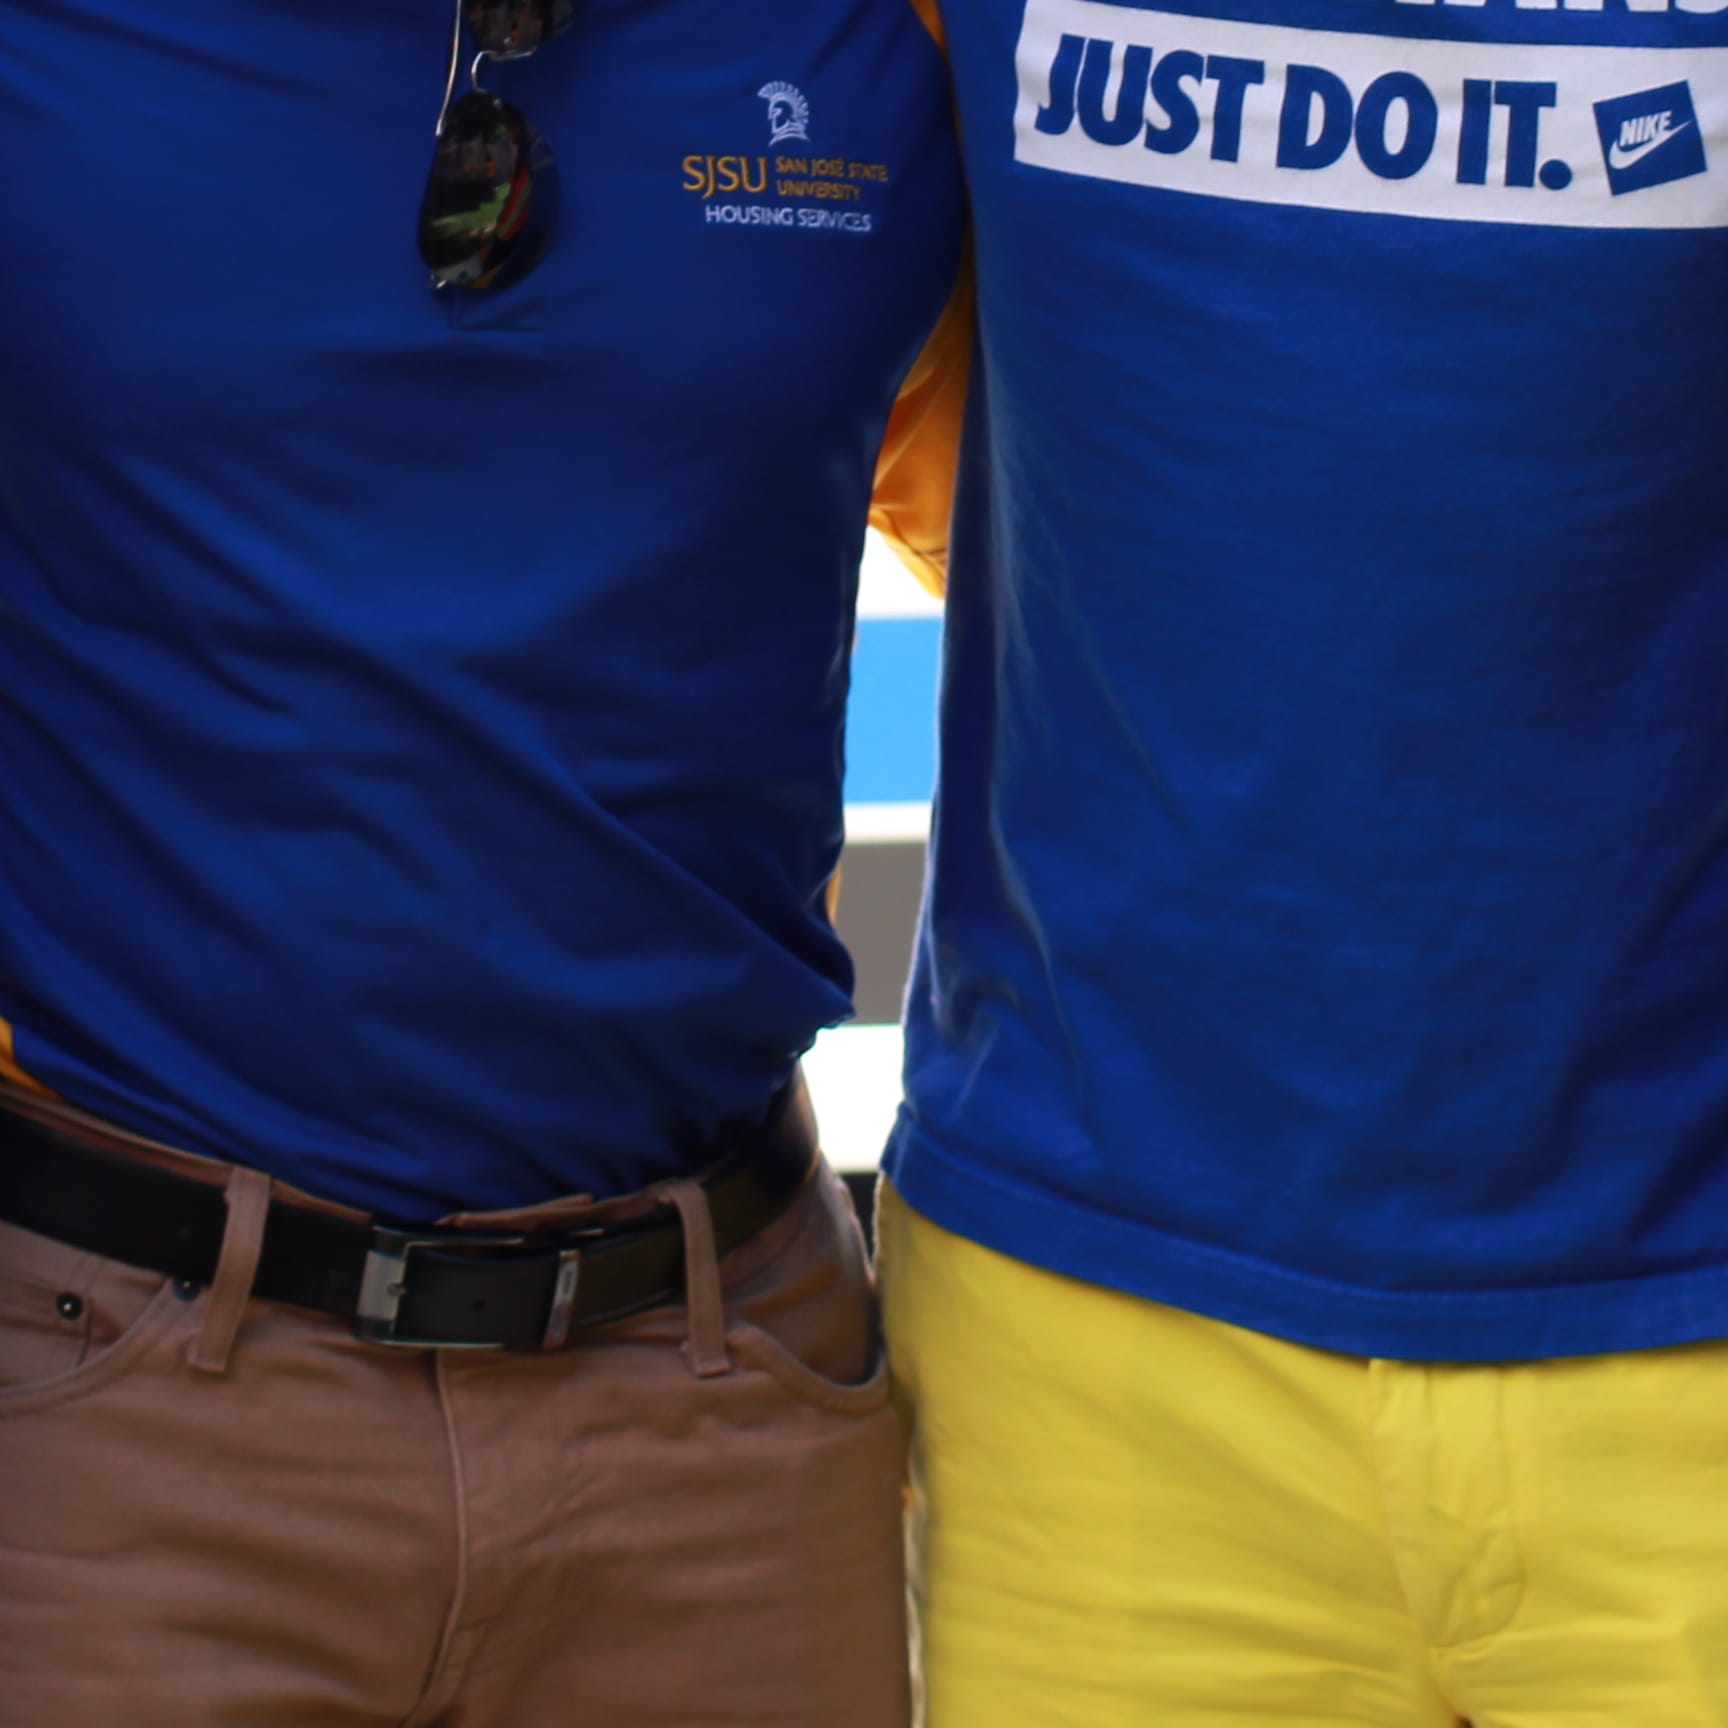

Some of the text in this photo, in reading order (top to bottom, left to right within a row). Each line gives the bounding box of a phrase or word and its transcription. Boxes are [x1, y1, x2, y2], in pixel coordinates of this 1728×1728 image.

[1035, 32, 1573, 191] JUST DO IT.
[1619, 110, 1672, 148] NIKE
[682, 155, 767, 199] SJSU
[775, 156, 809, 174] SAN
[848, 162, 888, 182] STATE
[777, 179, 860, 200] UNIVERSITY
[704, 205, 872, 232] HOUSING SERVICES
